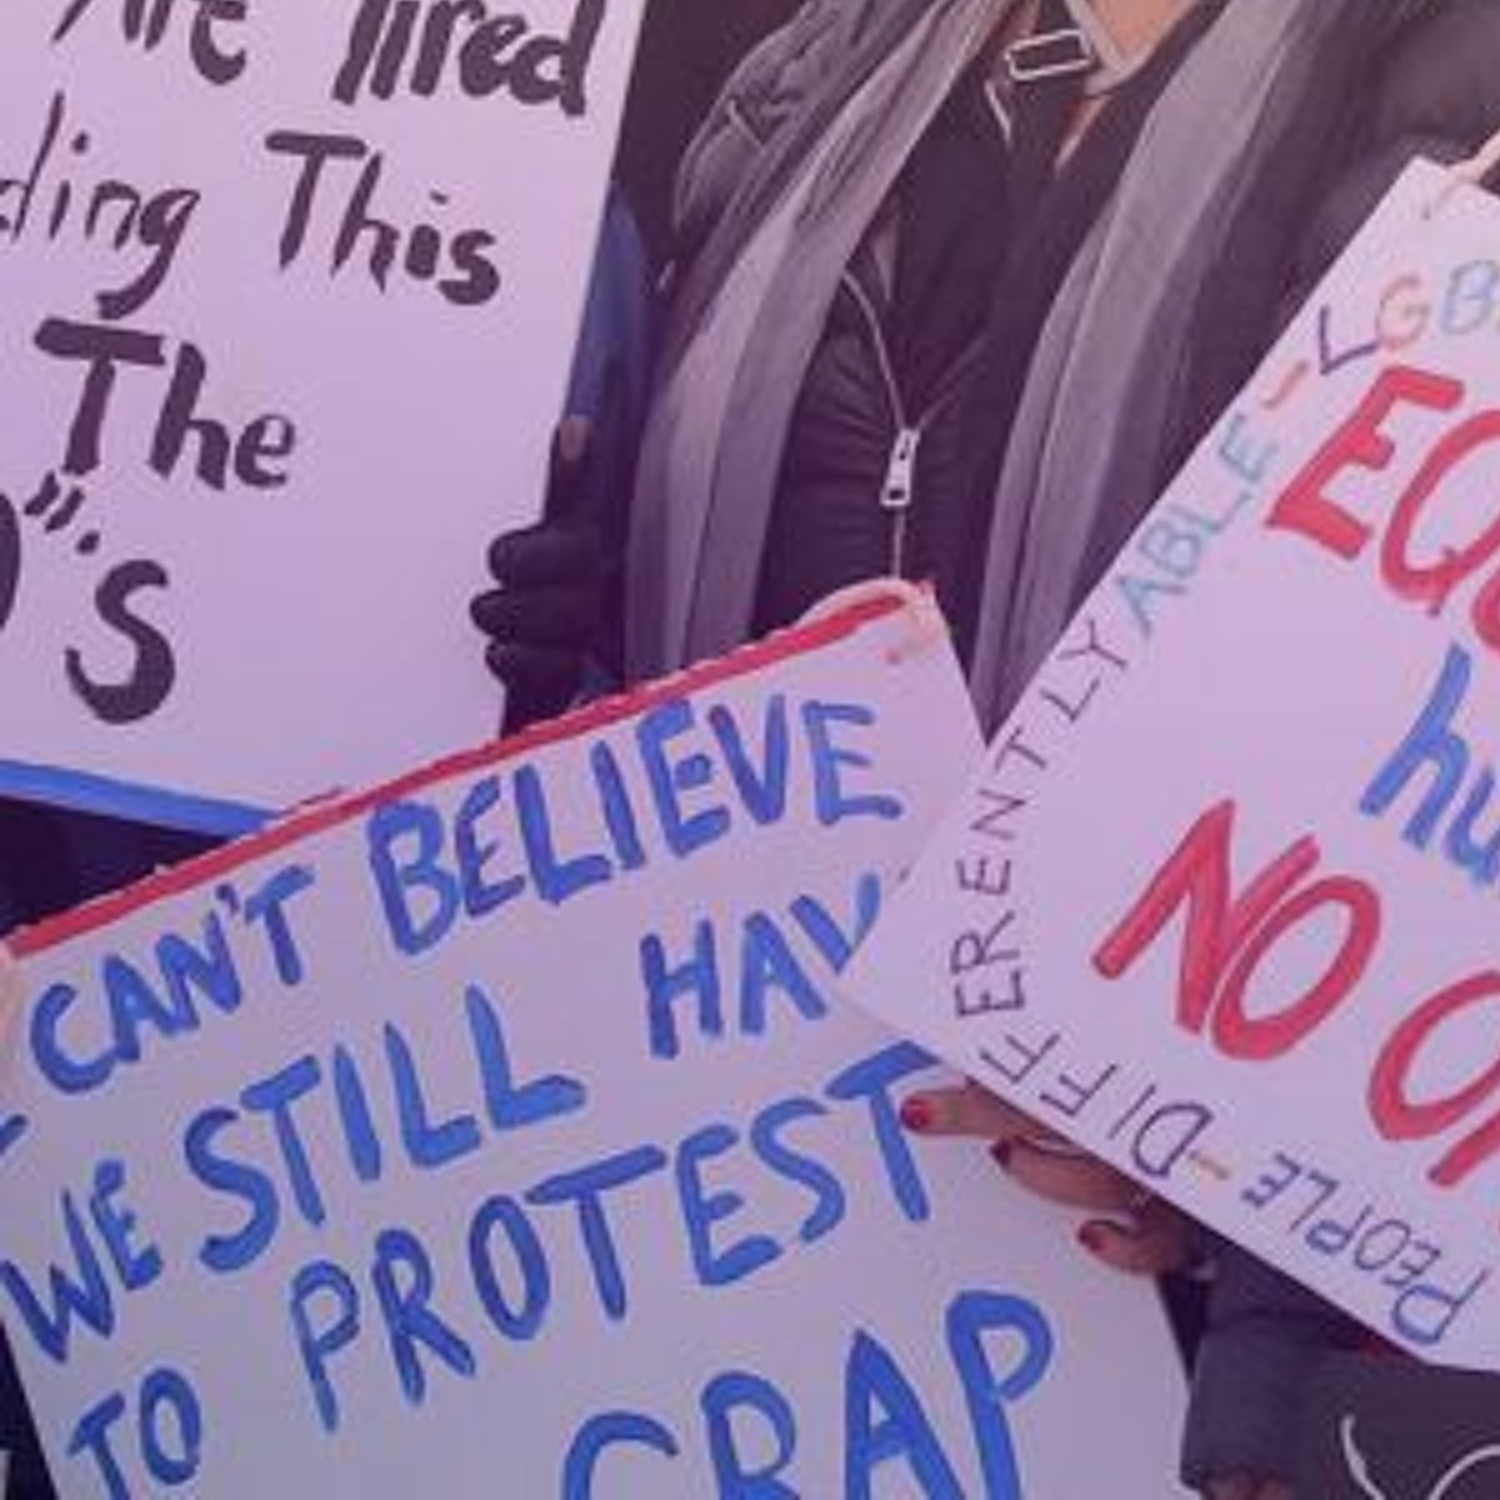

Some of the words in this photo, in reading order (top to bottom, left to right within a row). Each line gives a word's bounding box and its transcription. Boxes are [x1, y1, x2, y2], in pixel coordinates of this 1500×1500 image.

[264, 130, 501, 306] This
[34, 318, 296, 492] The
[30, 864, 315, 1094] CAN'T
[365, 692, 905, 957] BELIEVE
[1090, 798, 1382, 1062] NO
[0, 1158, 164, 1364] WE
[184, 984, 588, 1273] STILL
[639, 872, 882, 1060] HAV
[1240, 1150, 1490, 1346] PEOPLE
[66, 1366, 202, 1500] TO
[288, 1038, 943, 1434] PROTEST
